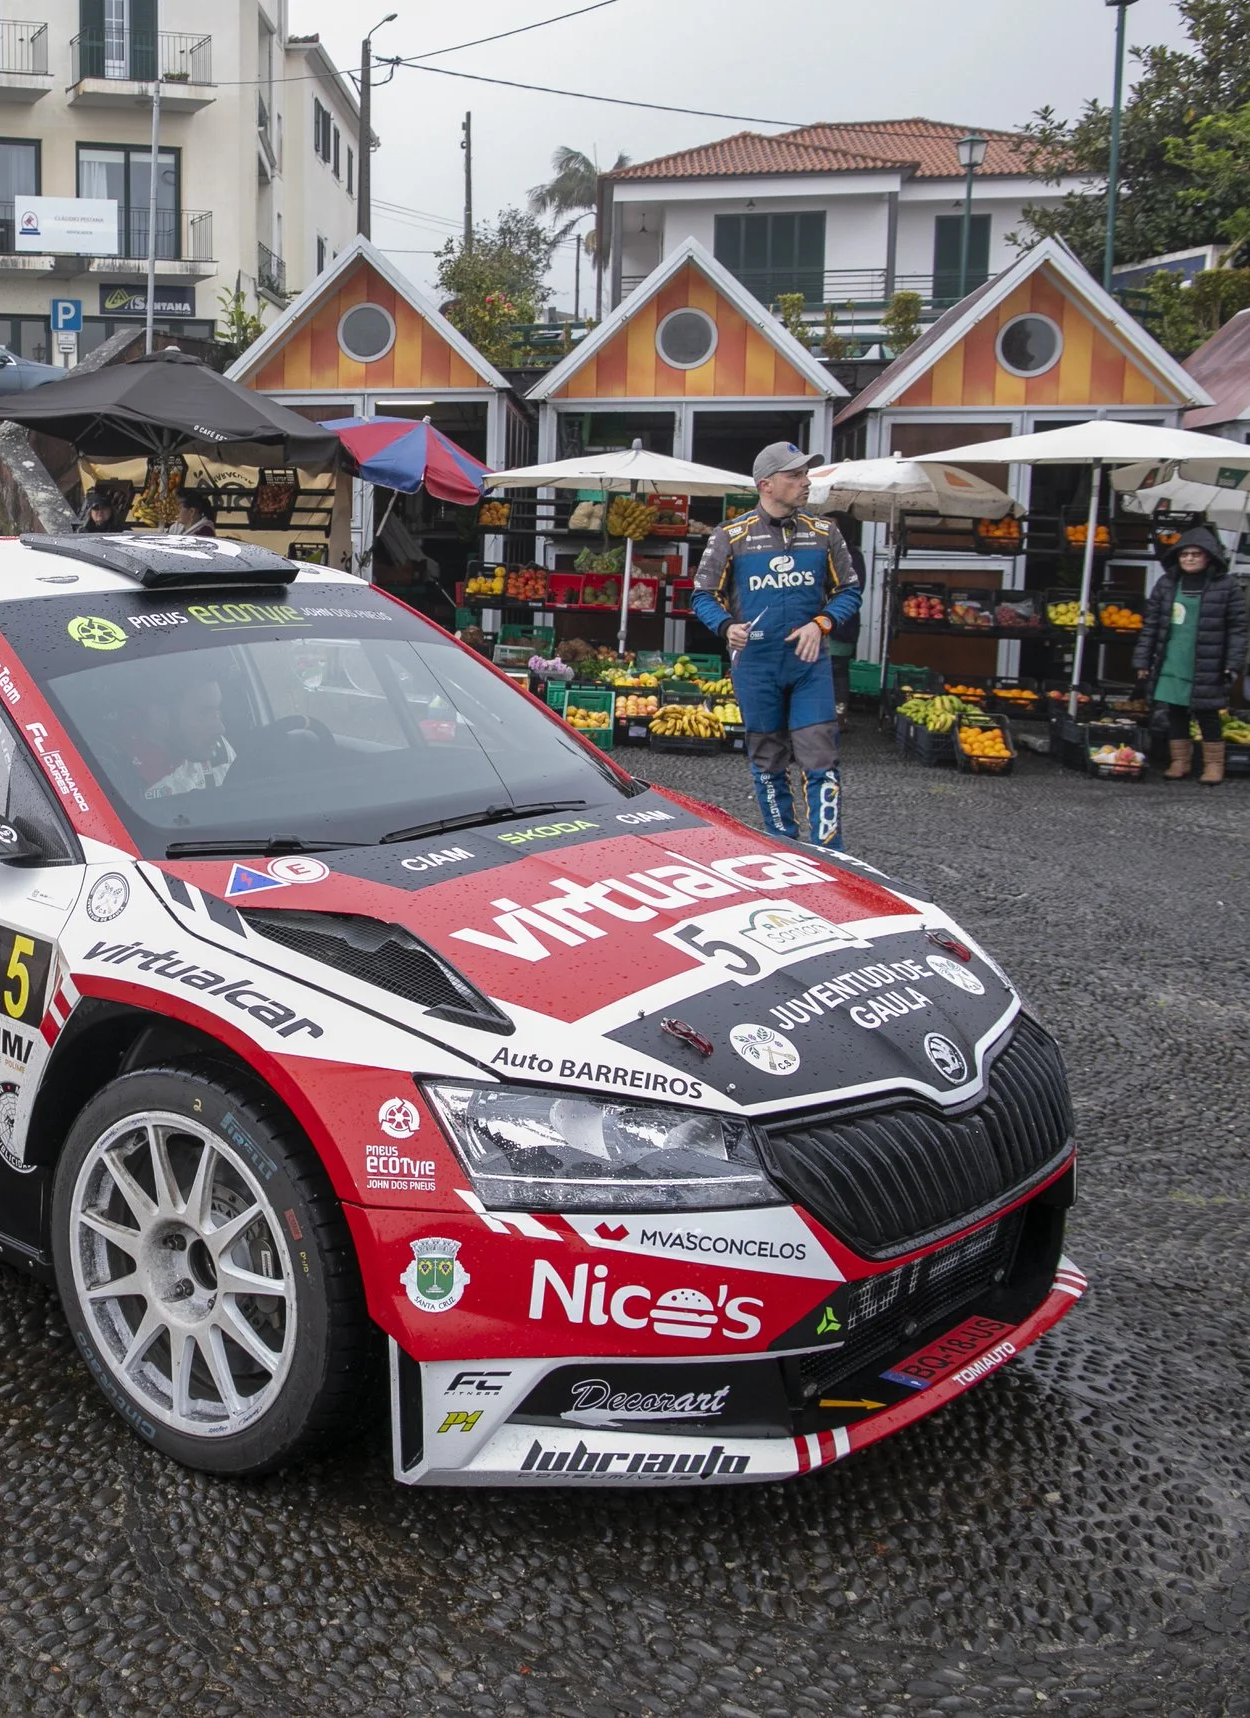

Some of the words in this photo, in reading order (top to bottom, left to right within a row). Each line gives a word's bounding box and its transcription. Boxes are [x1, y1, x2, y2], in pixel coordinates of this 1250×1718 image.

[57, 301, 76, 329] P
[134, 296, 191, 311] SNTANA
[749, 570, 816, 592] DARO'S
[300, 606, 331, 618] JOHN
[332, 608, 357, 619] DOS
[356, 609, 393, 621] PNEUS
[50, 750, 90, 813] FERNANDO
[616, 810, 676, 826] CIAM
[401, 847, 476, 873] CIAM
[449, 851, 838, 963] virtualcar
[673, 924, 761, 977] 5
[2, 933, 36, 1019] 5
[890, 958, 935, 981] DE
[81, 940, 325, 1040] virtualcar
[849, 986, 934, 1029] GAULA
[490, 1046, 554, 1073] Auto
[558, 1058, 704, 1100] BARREIROS
[366, 1179, 390, 1190] JOHN
[391, 1180, 408, 1191] DOS
[409, 1181, 437, 1192] PNEUS
[639, 1228, 807, 1261] MVASCONCELOS
[413, 1295, 437, 1311] SANTA
[438, 1296, 457, 1311] CRUZ
[900, 1315, 1007, 1380] BQ-18-US
[951, 1341, 1017, 1387] TOMIAUTO
[446, 1371, 513, 1391] FC
[571, 1378, 732, 1414] Decorart
[436, 1410, 484, 1434] P1
[519, 1438, 751, 1480] lubriauto
